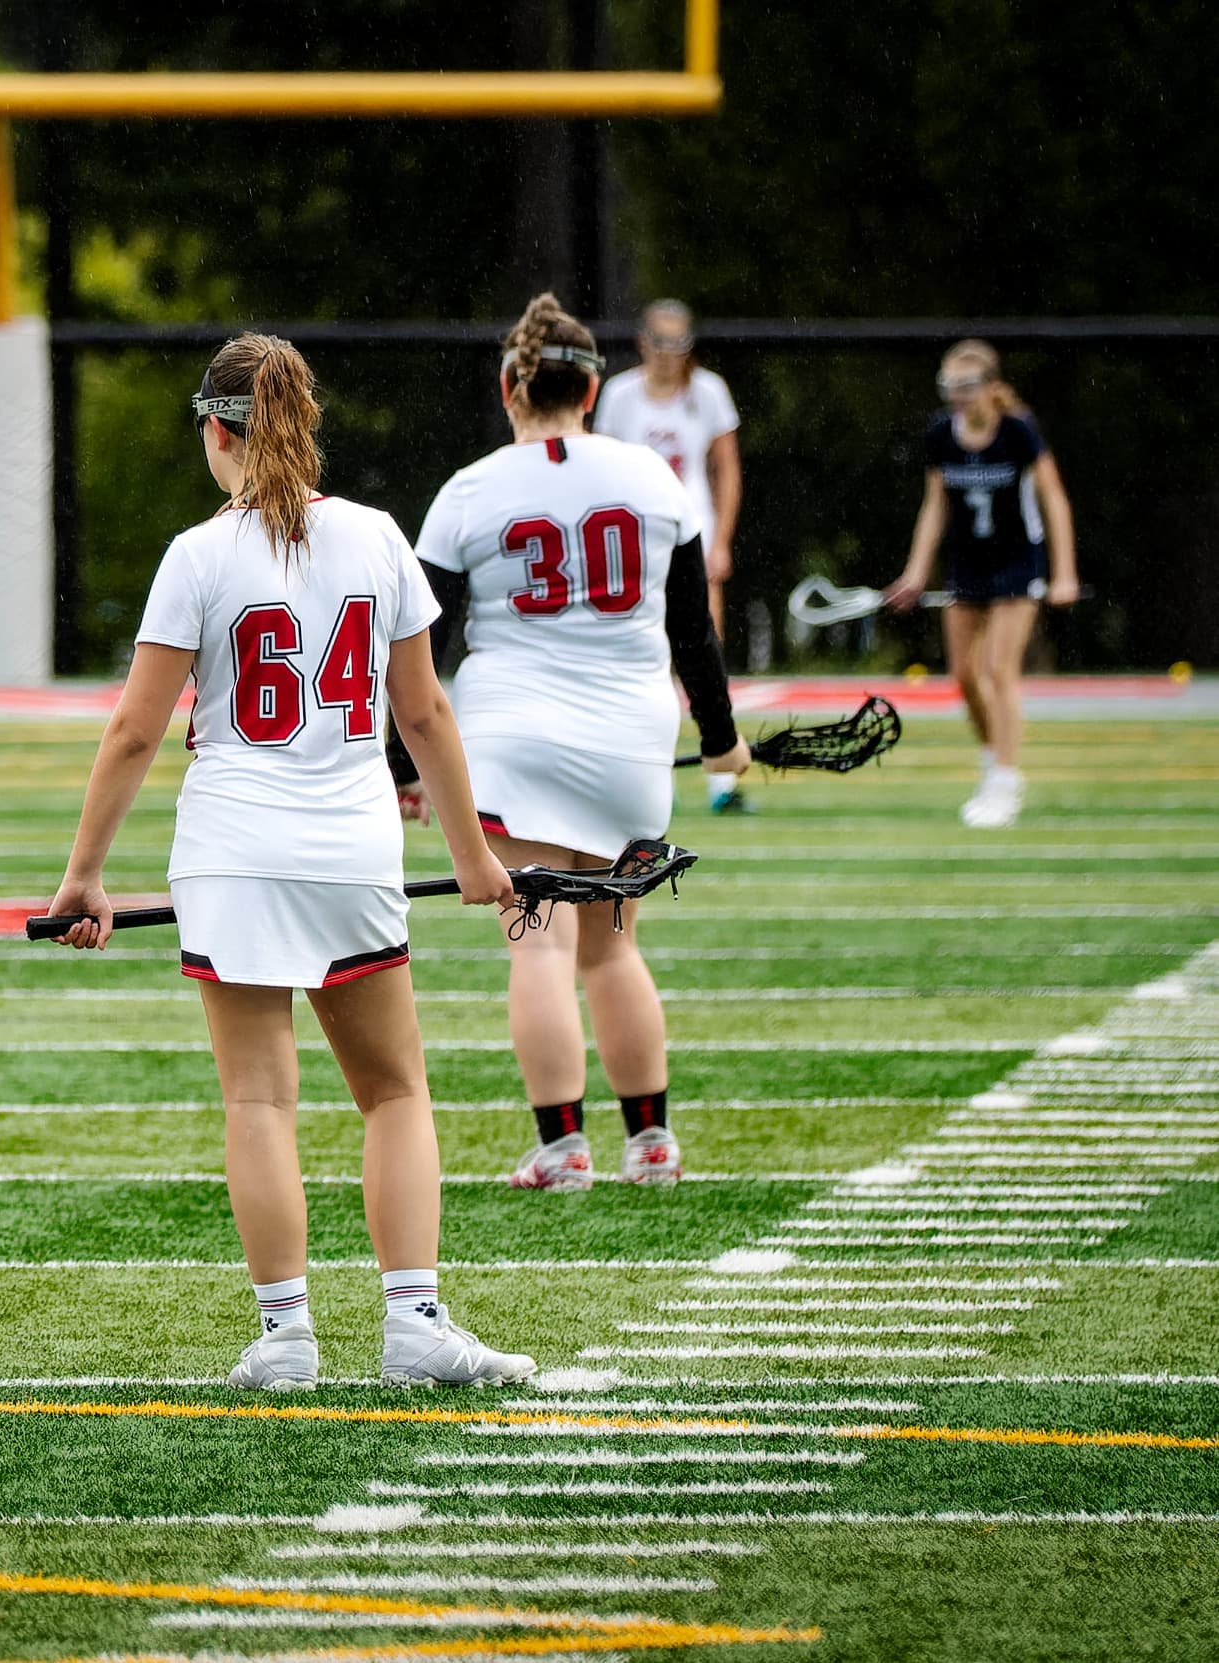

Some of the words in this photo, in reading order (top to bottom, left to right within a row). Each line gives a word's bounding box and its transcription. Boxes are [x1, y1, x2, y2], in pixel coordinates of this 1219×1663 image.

[207, 398, 232, 412] STX
[964, 490, 995, 539] 7
[500, 504, 646, 621] 30
[229, 594, 378, 747] 64
